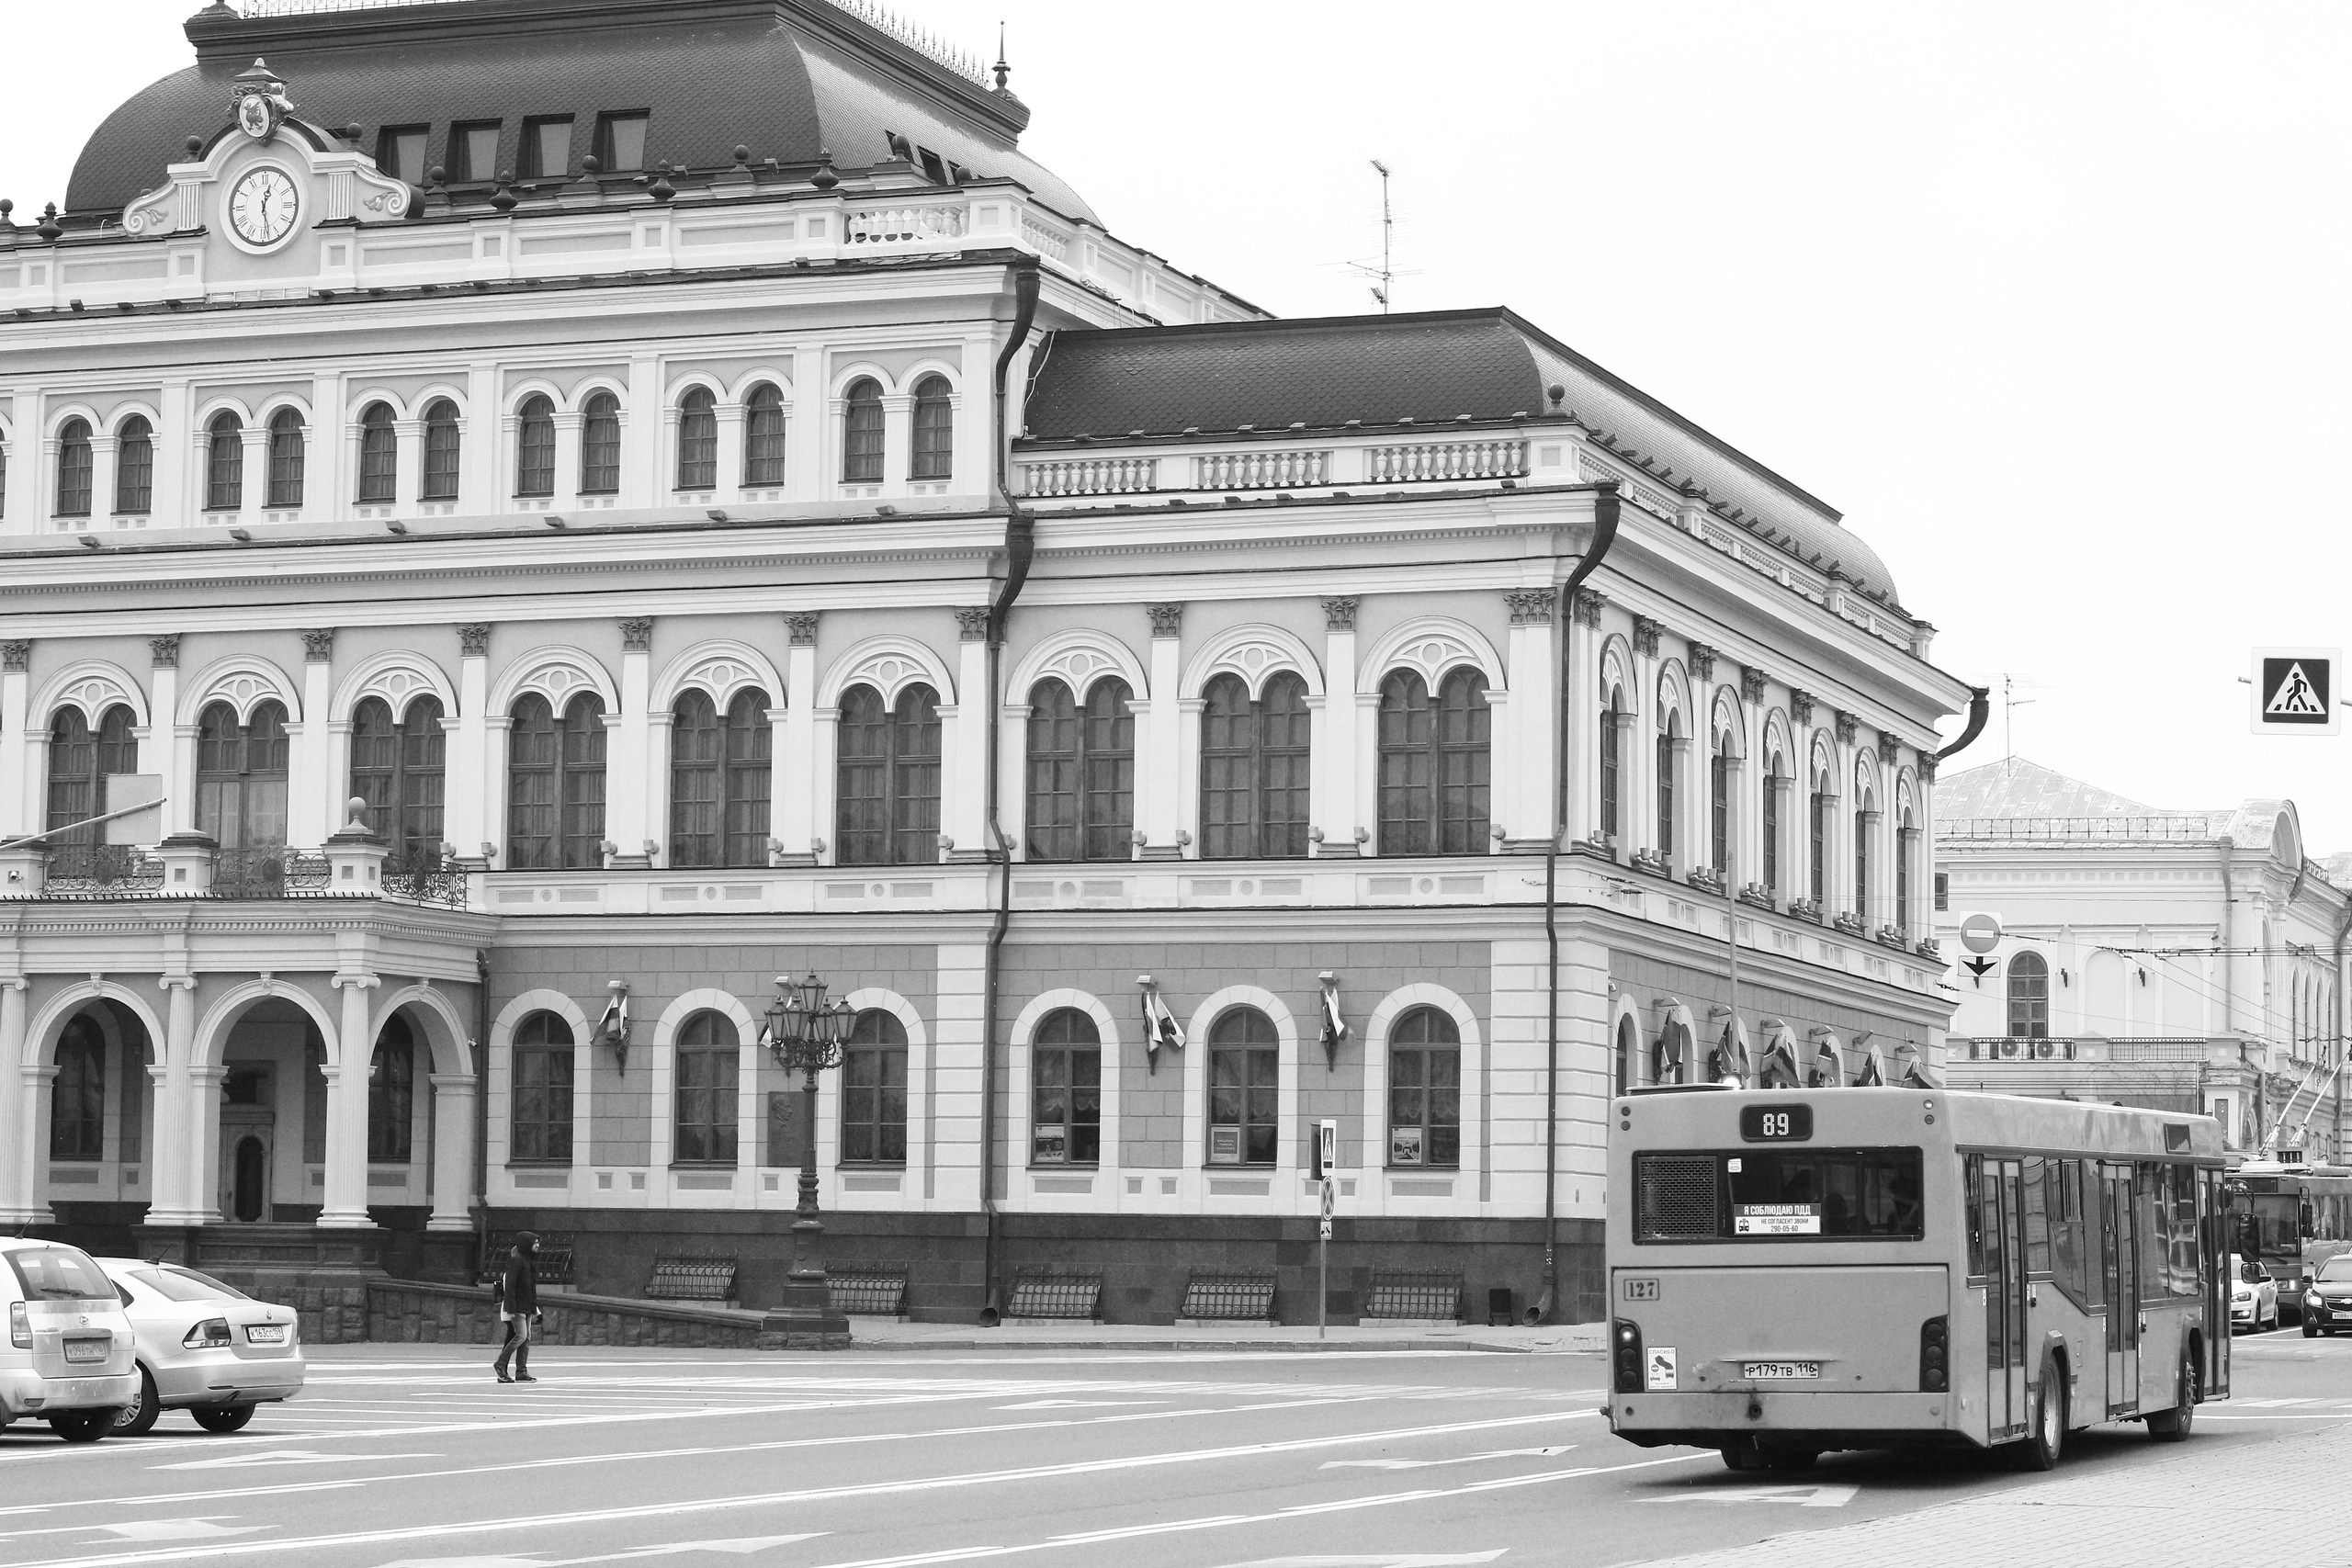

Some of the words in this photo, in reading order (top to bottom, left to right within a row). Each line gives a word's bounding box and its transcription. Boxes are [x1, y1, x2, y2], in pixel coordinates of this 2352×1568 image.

[1763, 1112, 1789, 1136] 89
[1744, 1205, 1749, 1215] Я
[1750, 1205, 1793, 1215] СОБЛЮДАЮ
[1794, 1204, 1812, 1215] ПДД
[1629, 1281, 1656, 1297] 127
